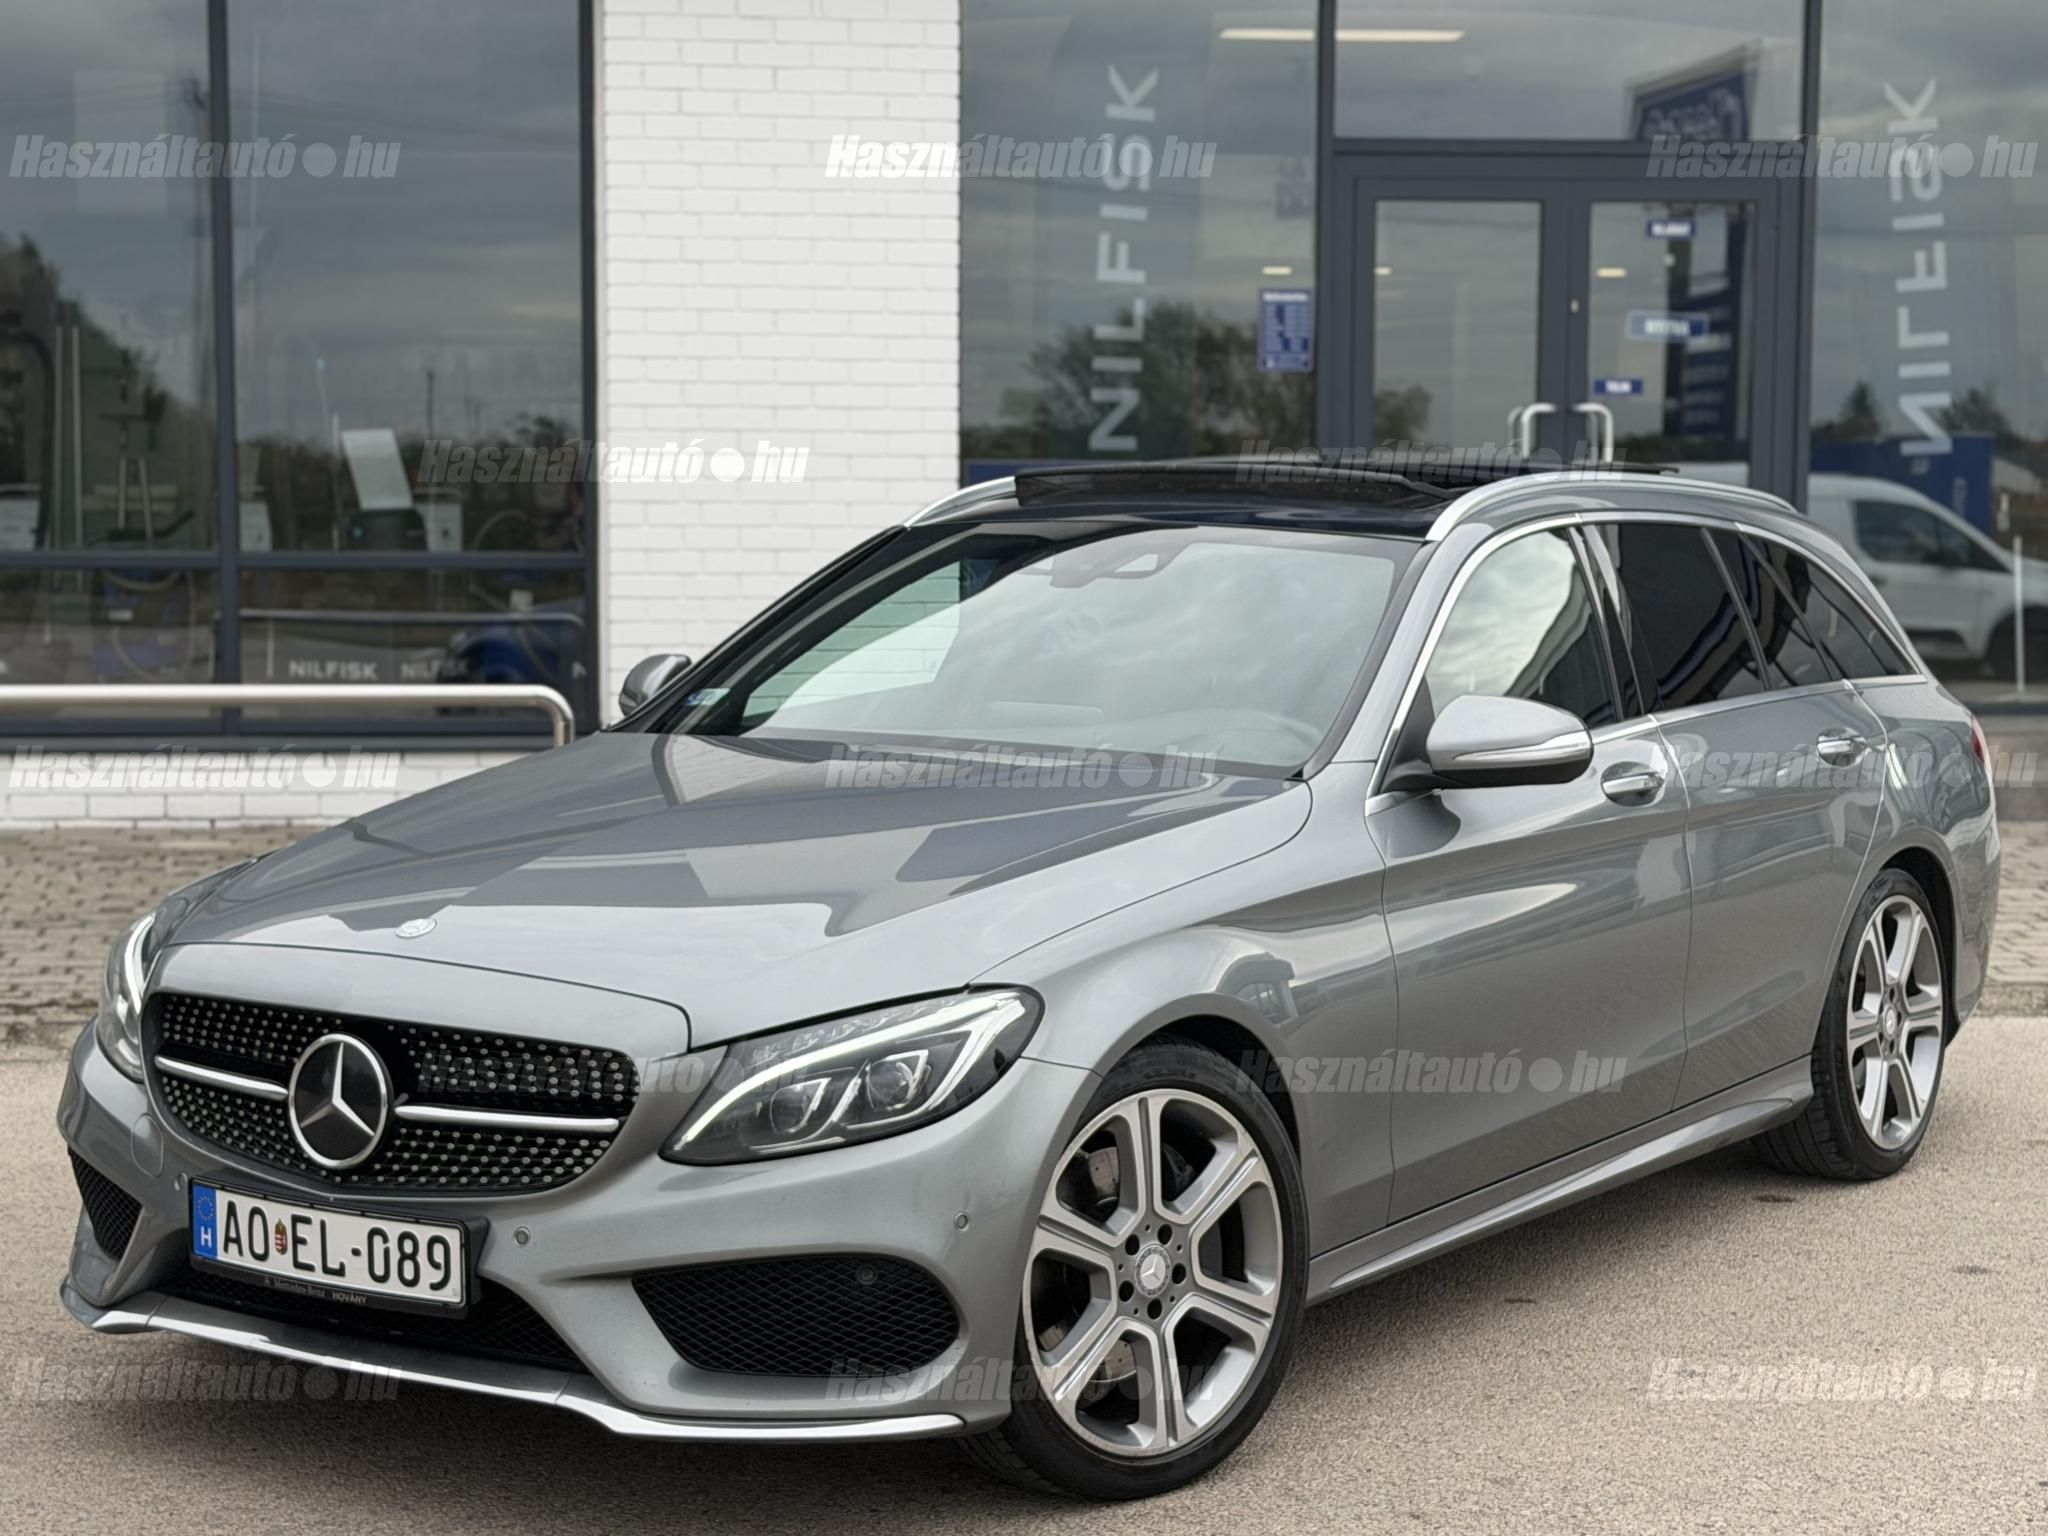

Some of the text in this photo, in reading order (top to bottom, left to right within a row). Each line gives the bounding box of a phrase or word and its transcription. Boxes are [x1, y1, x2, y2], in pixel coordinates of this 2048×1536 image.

[1089, 65, 1159, 452] NILFISK
[288, 659, 379, 681] NILFISK
[200, 1226, 212, 1248] H
[223, 1200, 451, 1291] AO EL-089
